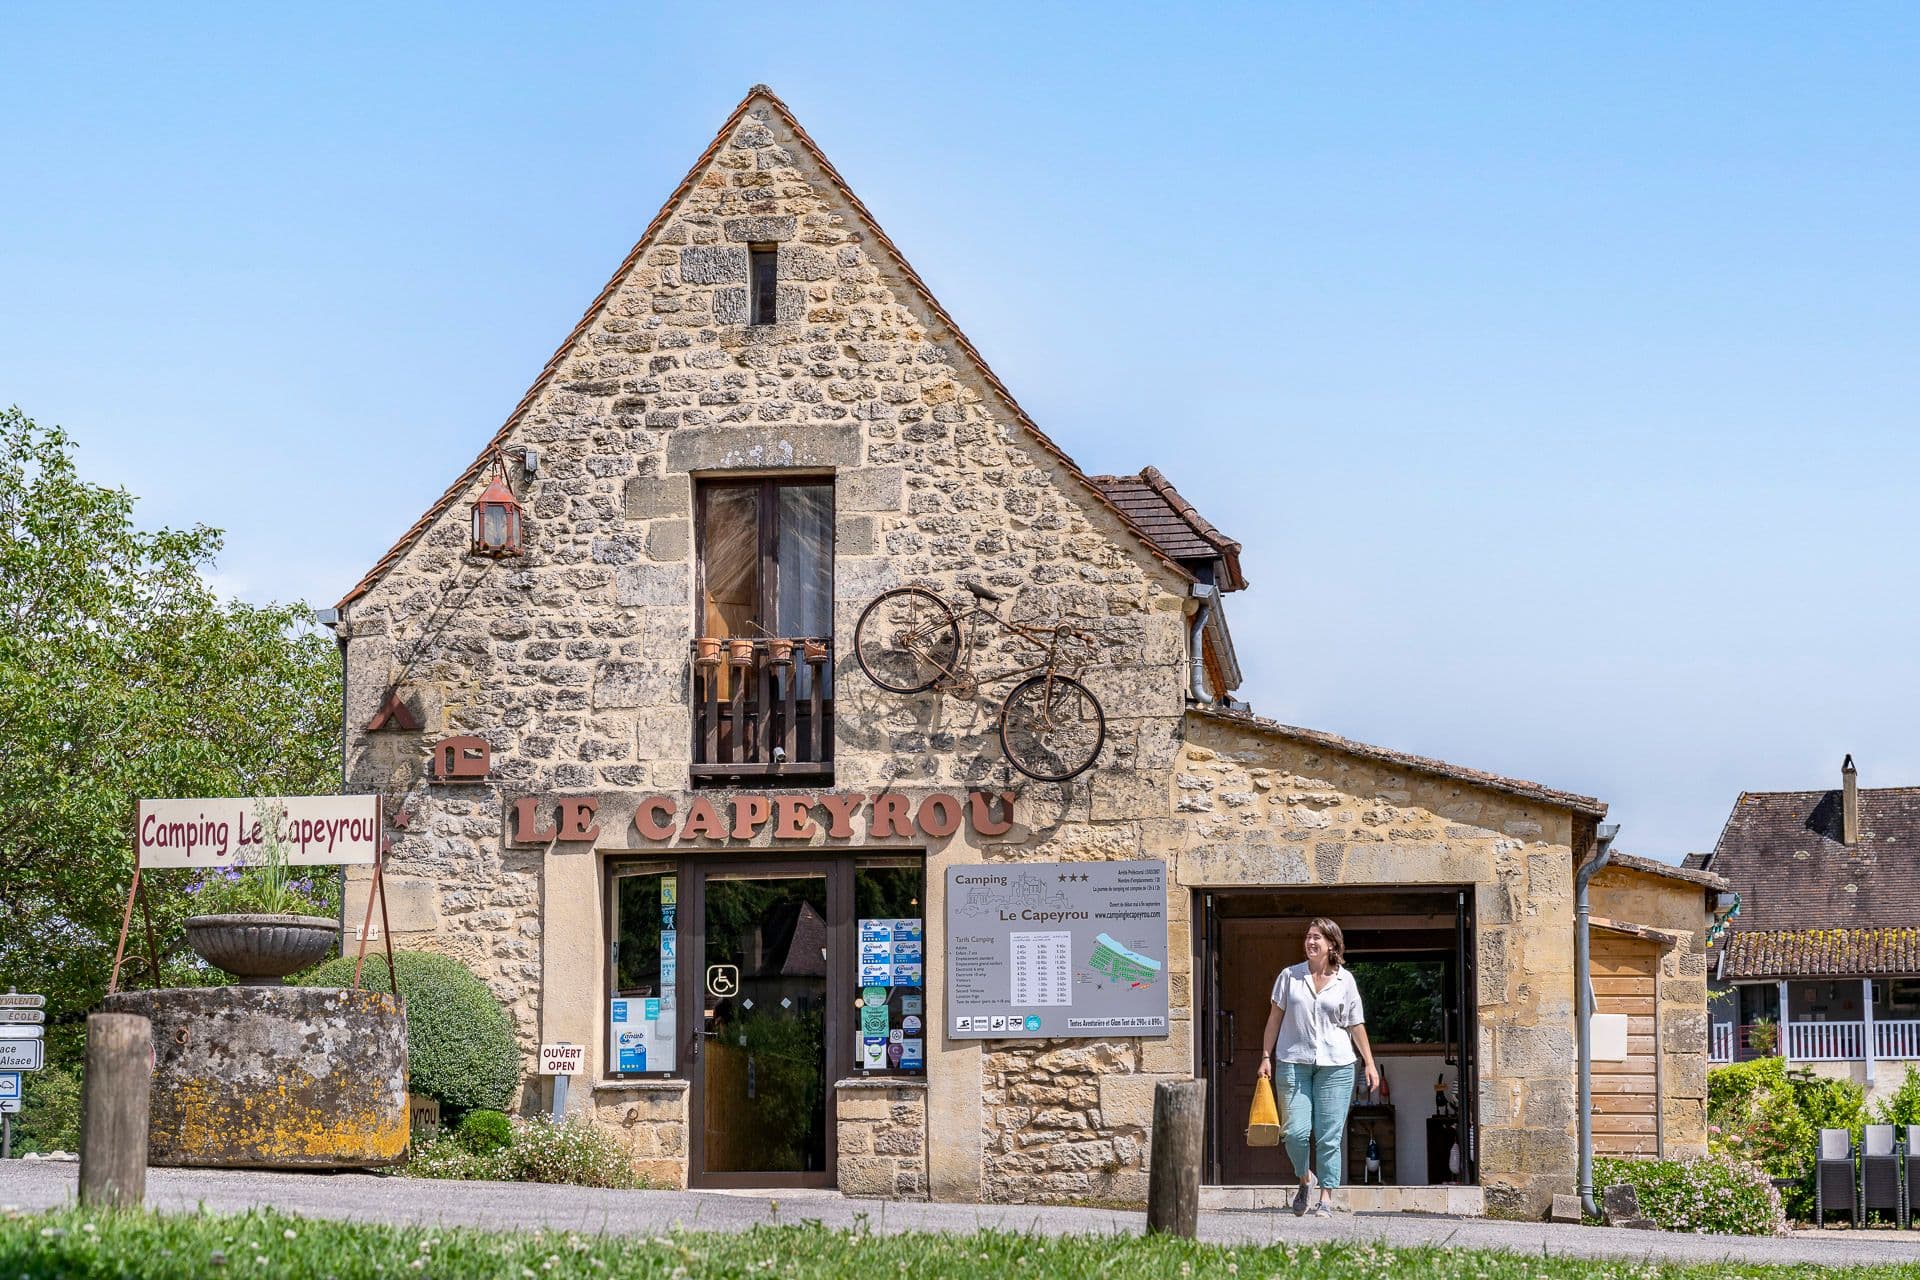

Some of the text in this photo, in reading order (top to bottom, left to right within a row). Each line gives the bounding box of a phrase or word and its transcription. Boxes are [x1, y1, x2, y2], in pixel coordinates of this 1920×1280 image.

[513, 791, 1015, 842] LE CAPEYROU
[142, 813, 229, 857] Camping
[239, 811, 263, 846] Le
[956, 874, 1008, 886] Camping
[1000, 909, 1088, 923] Le Capeyrou
[1095, 910, 1160, 920] www.campinglecapeyrou.com
[970, 936, 994, 944] Camping
[544, 1048, 581, 1058] OUVERT
[0, 1056, 32, 1065] Alsace
[548, 1061, 575, 1070] OPEN
[410, 1108, 436, 1130] yrou
